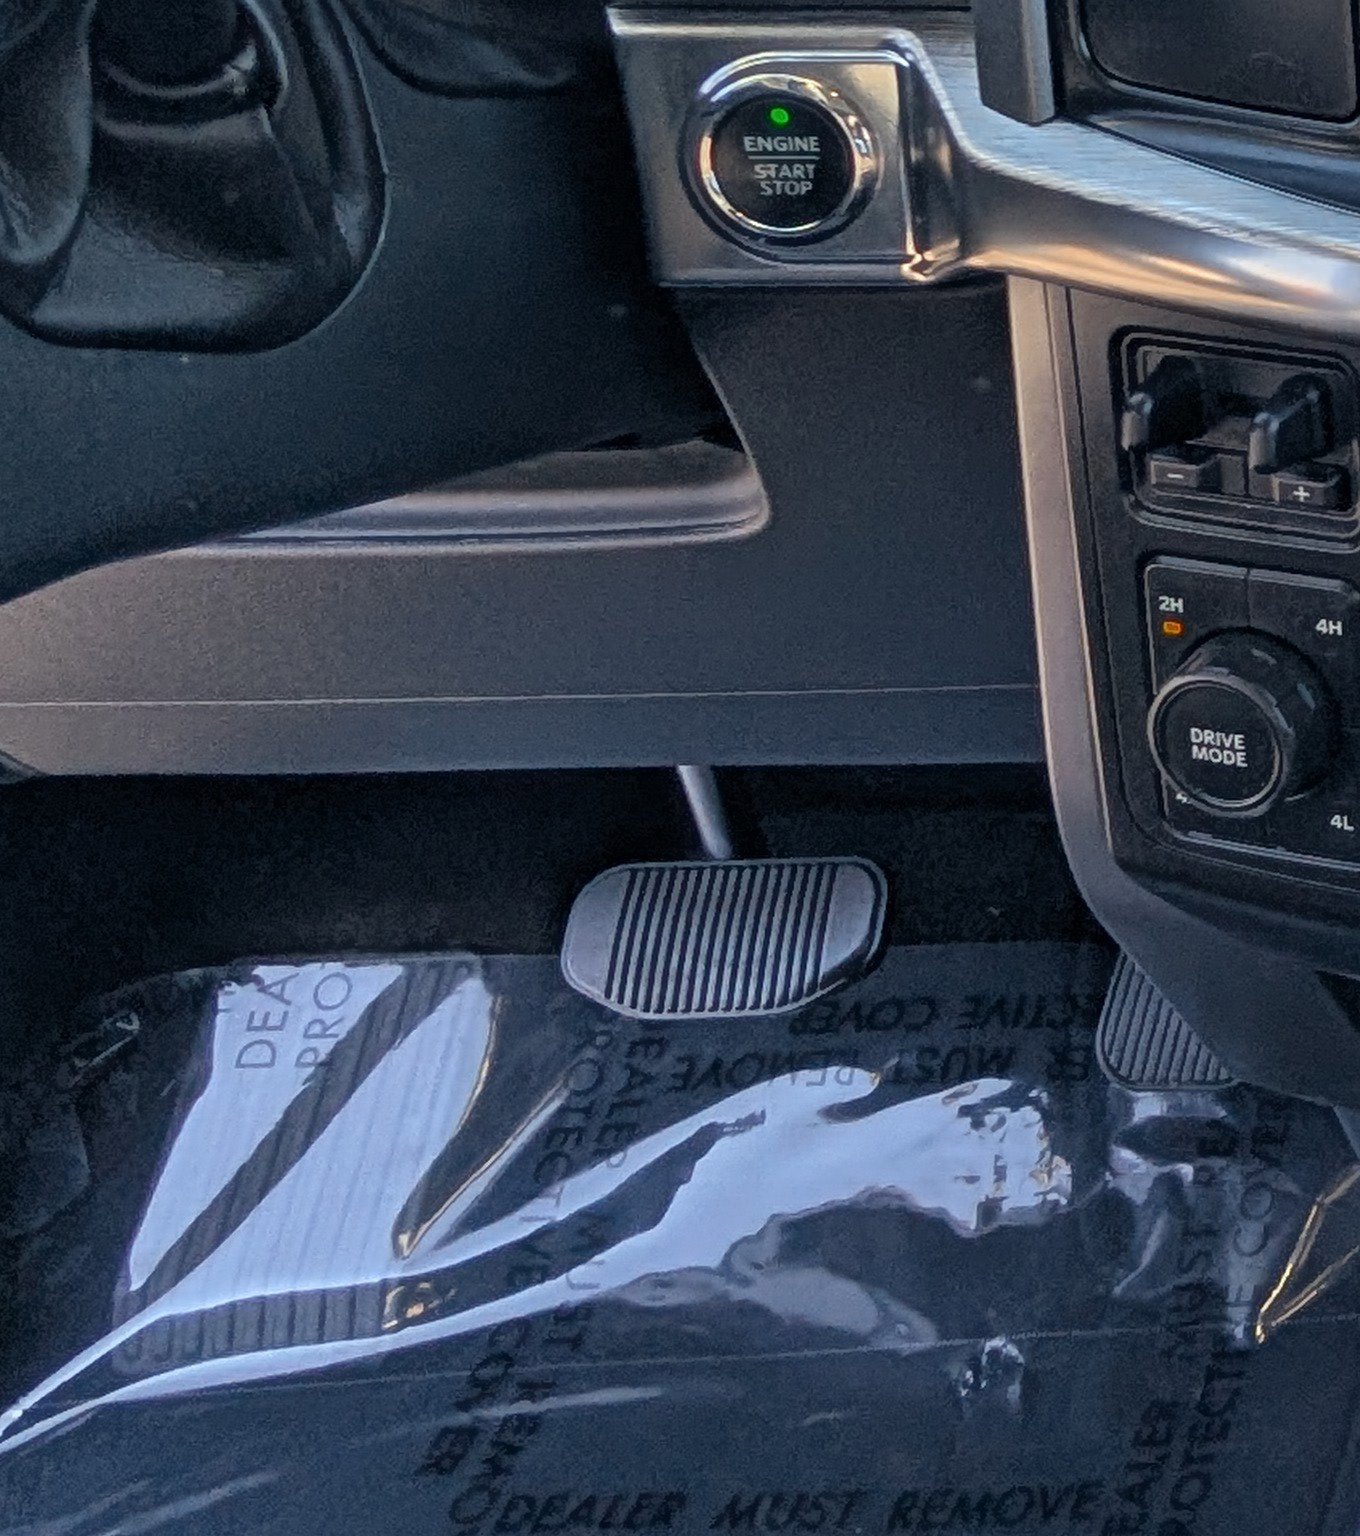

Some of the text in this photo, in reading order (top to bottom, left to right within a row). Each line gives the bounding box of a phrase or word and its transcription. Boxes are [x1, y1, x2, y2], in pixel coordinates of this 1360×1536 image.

[743, 135, 820, 153] ENGINE
[754, 163, 815, 180] START
[760, 180, 813, 196] STOP
[1158, 596, 1184, 614] 2H
[1315, 618, 1343, 637] 4H
[1190, 726, 1246, 751] DRIVE
[1190, 745, 1248, 768] MODE
[1329, 813, 1355, 832] 4L
[708, 1486, 876, 1536] MUST
[887, 1478, 1105, 1536] REMOVE
